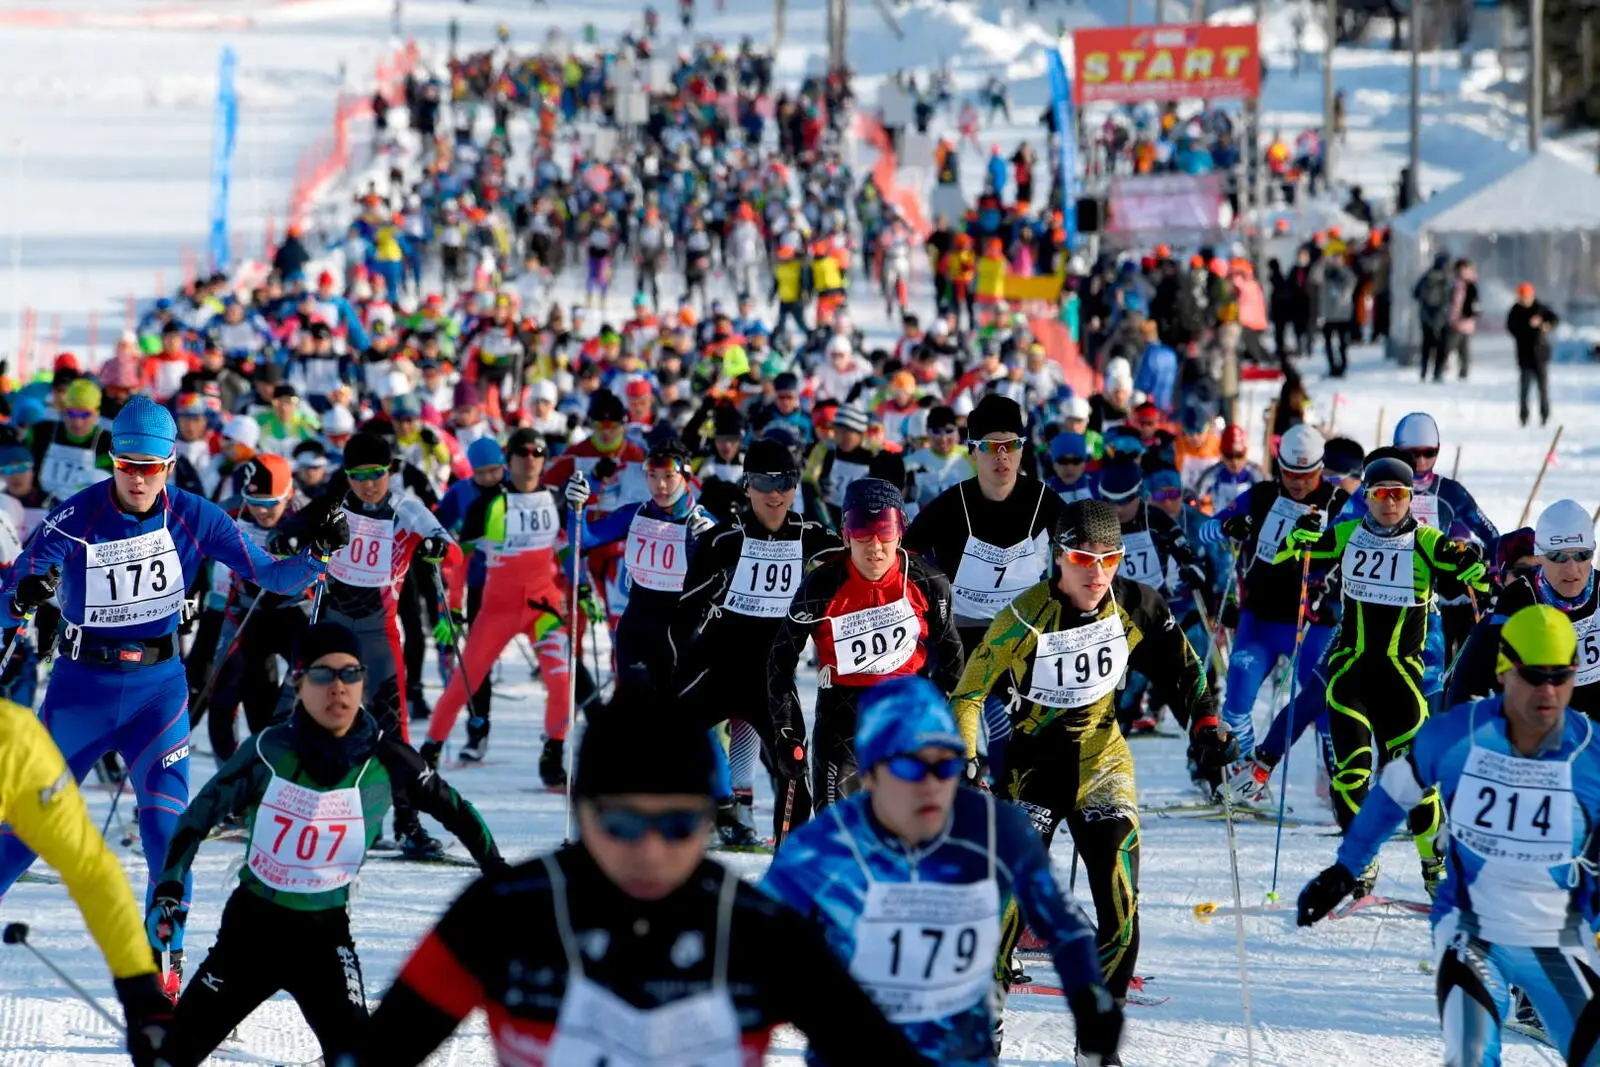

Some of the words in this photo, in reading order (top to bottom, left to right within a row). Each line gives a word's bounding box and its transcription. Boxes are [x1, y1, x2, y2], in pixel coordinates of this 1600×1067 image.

[1082, 46, 1250, 83] START
[520, 509, 551, 532] 180
[336, 538, 380, 568] 08
[636, 538, 675, 569] 710
[1352, 550, 1398, 582] 221
[106, 560, 167, 600] 173
[750, 562, 792, 592] 199
[994, 566, 1007, 588] 7
[852, 626, 906, 666] 202
[1054, 646, 1113, 687] 196
[1474, 786, 1552, 837] 214
[272, 814, 348, 862] 707
[888, 927, 978, 980] 179
